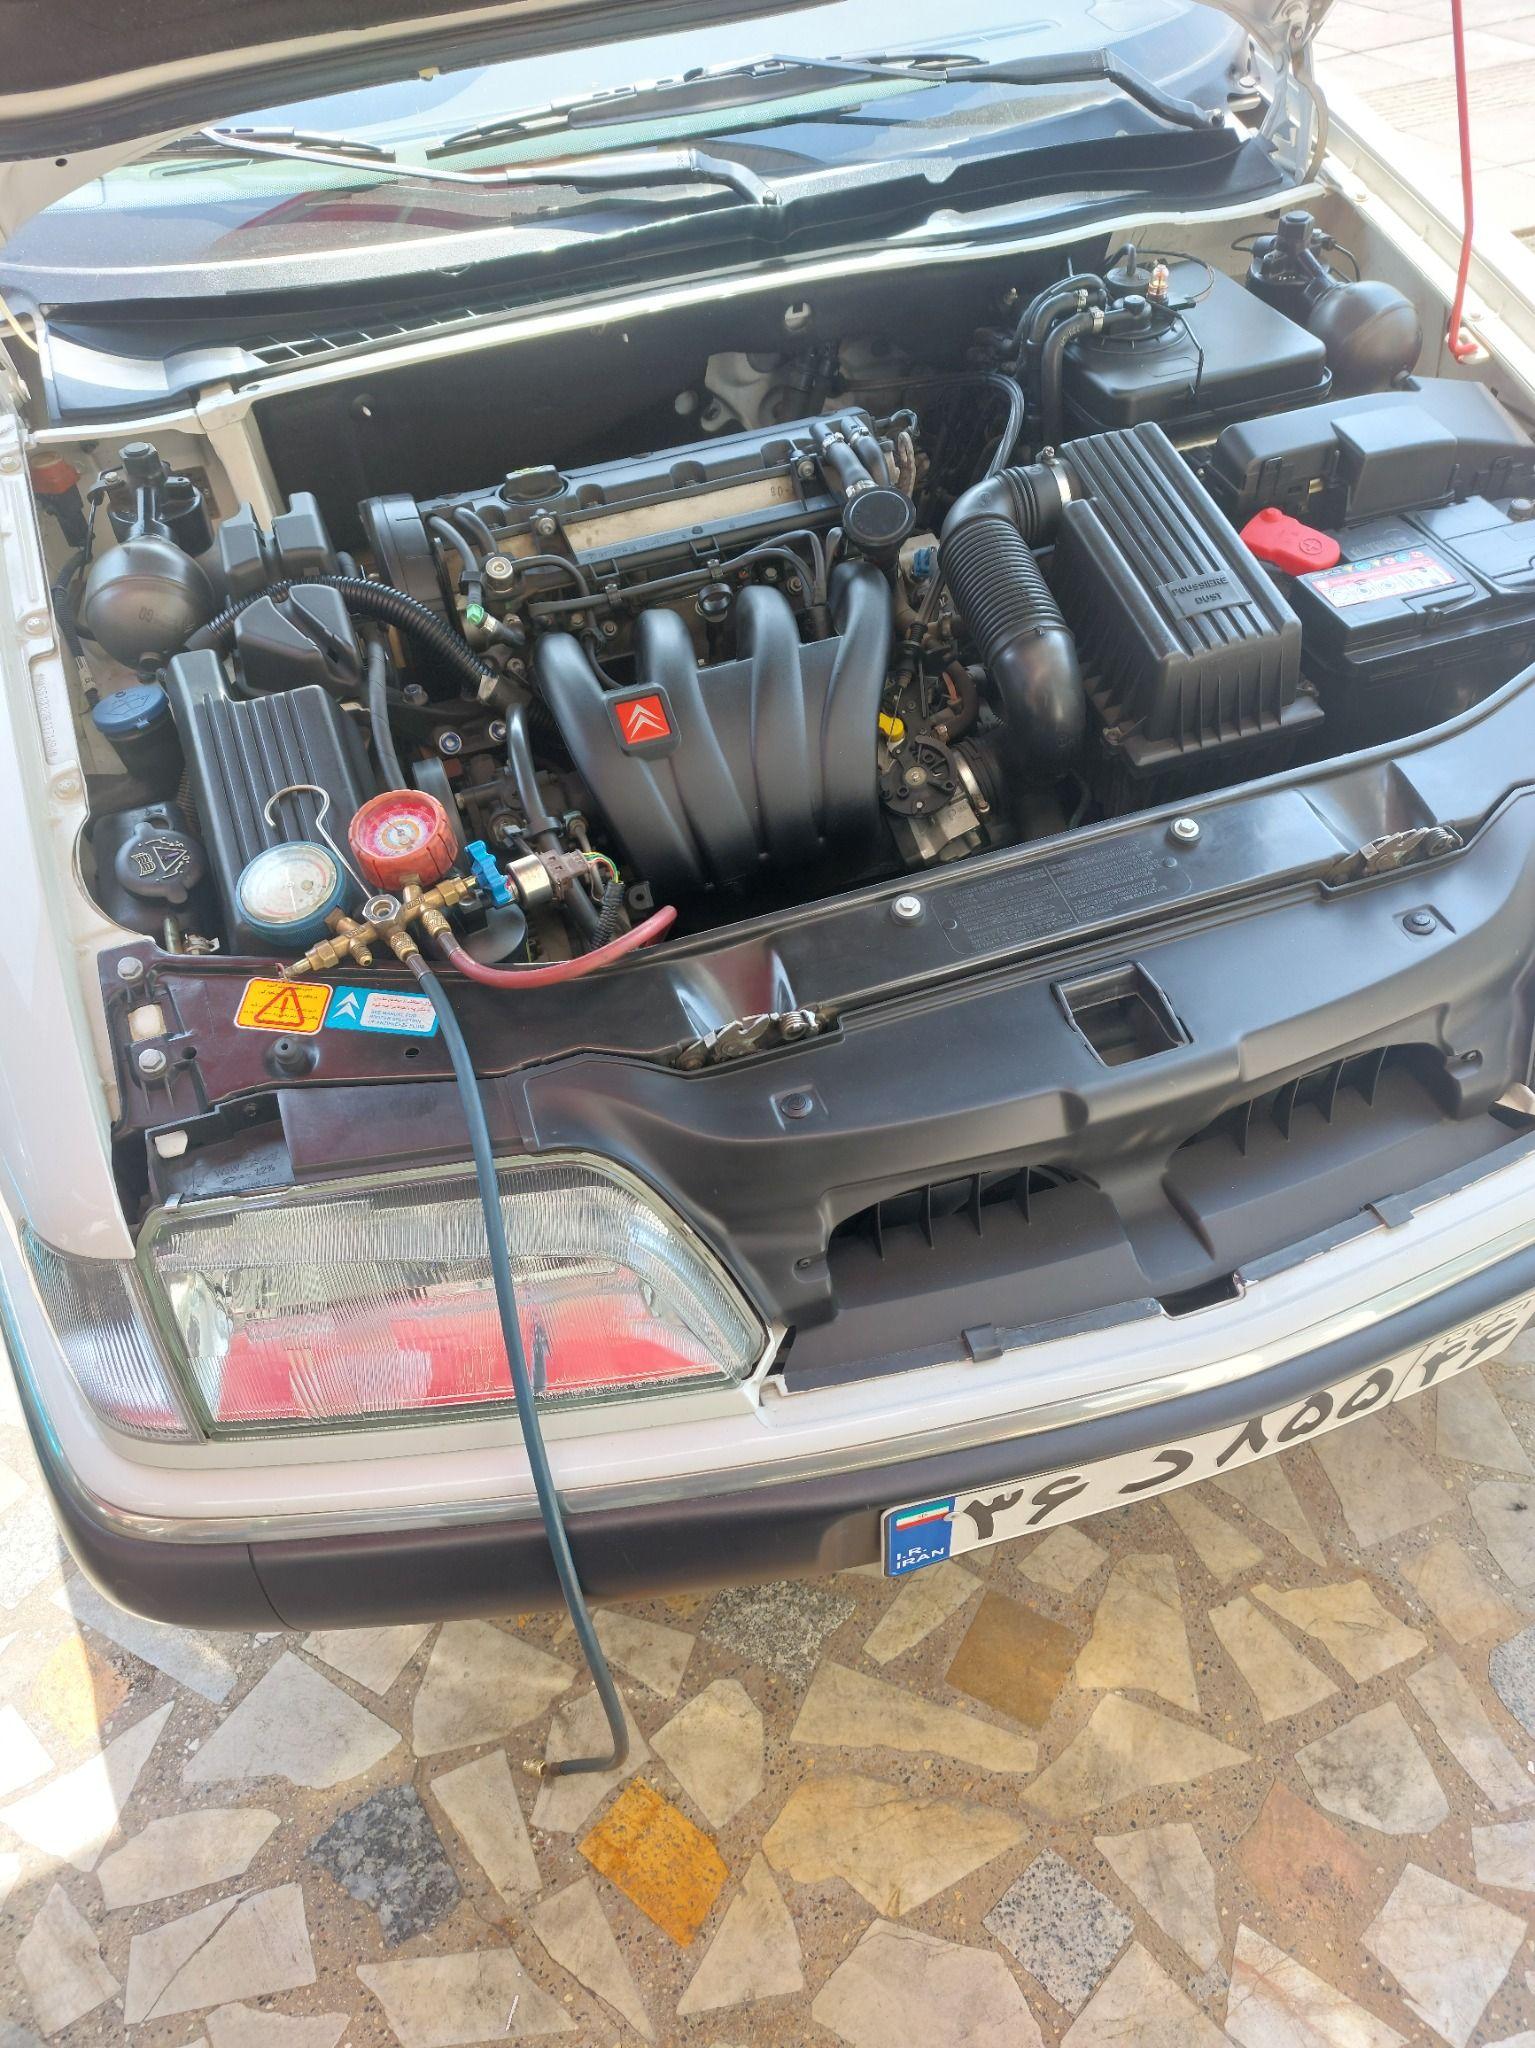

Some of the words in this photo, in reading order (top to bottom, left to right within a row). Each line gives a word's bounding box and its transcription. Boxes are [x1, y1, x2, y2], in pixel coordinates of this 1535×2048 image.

[1194, 592, 1222, 605] DUST
[896, 1546, 928, 1561] I.R.
[896, 1547, 945, 1570] IRAN
